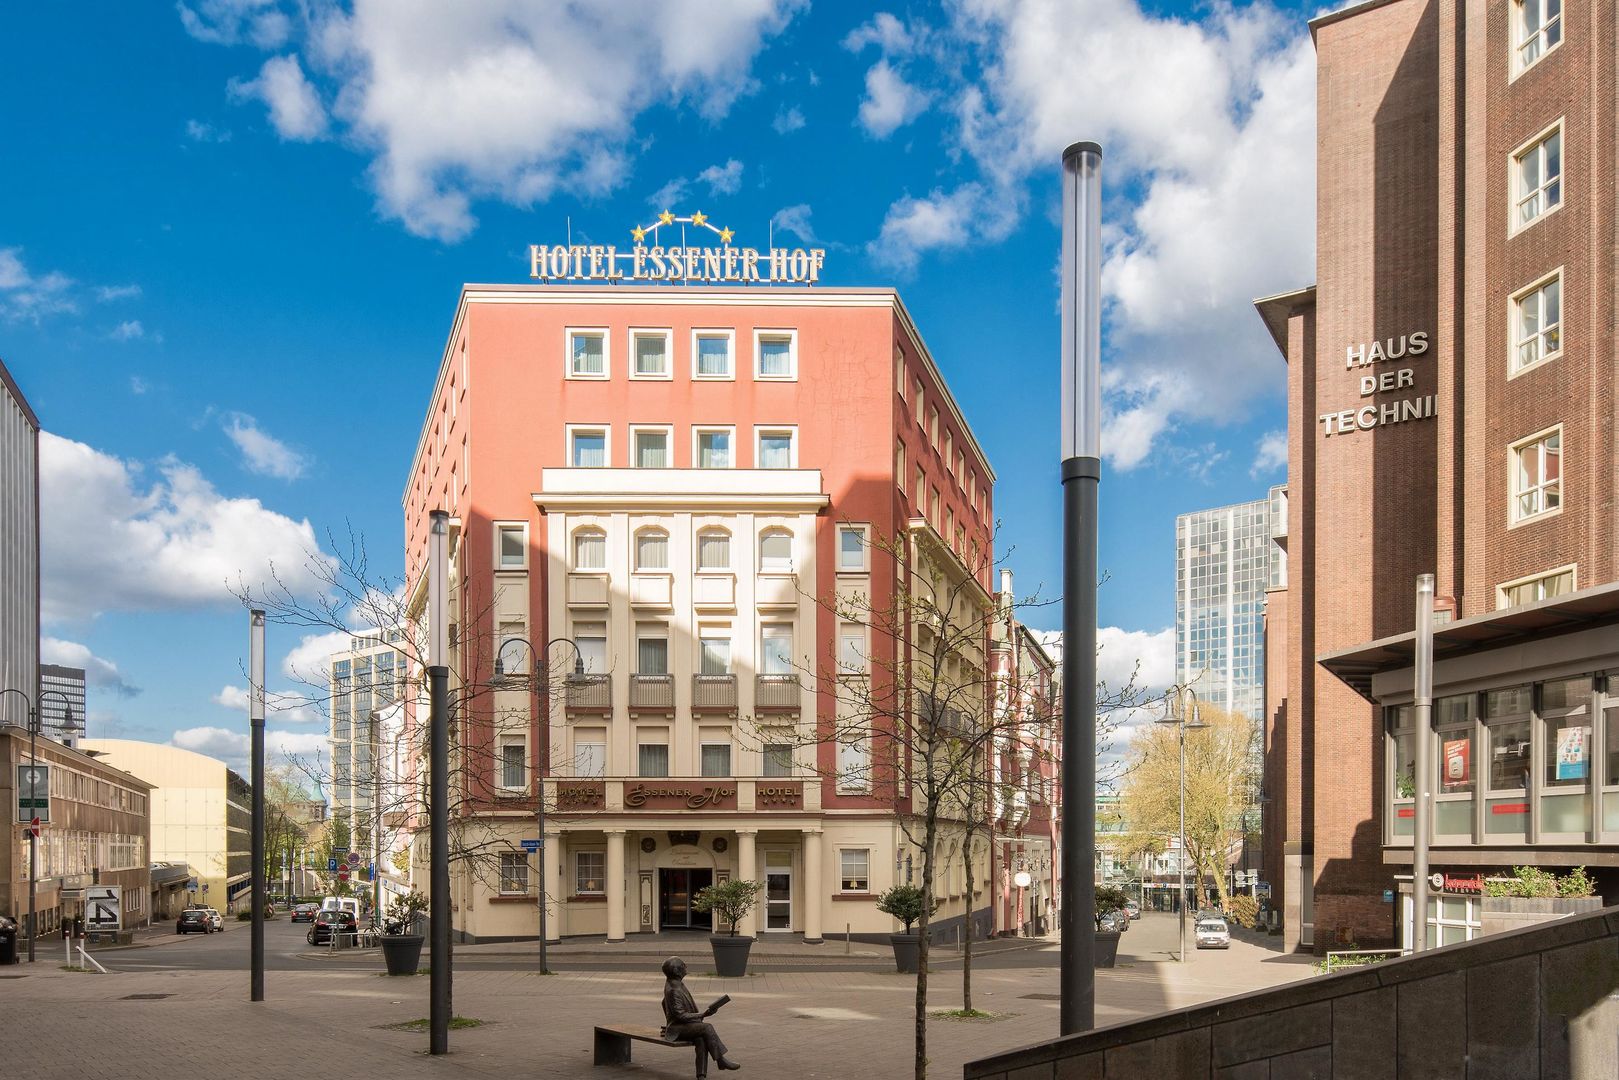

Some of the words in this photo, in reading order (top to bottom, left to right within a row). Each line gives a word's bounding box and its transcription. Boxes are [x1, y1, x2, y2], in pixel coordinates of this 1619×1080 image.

[529, 244, 623, 280] HOTEL
[632, 246, 759, 281] ESSENER
[769, 247, 826, 283] HOF
[1346, 331, 1429, 370] HAUS
[1360, 368, 1414, 397] DER
[757, 787, 802, 797] HOTEL
